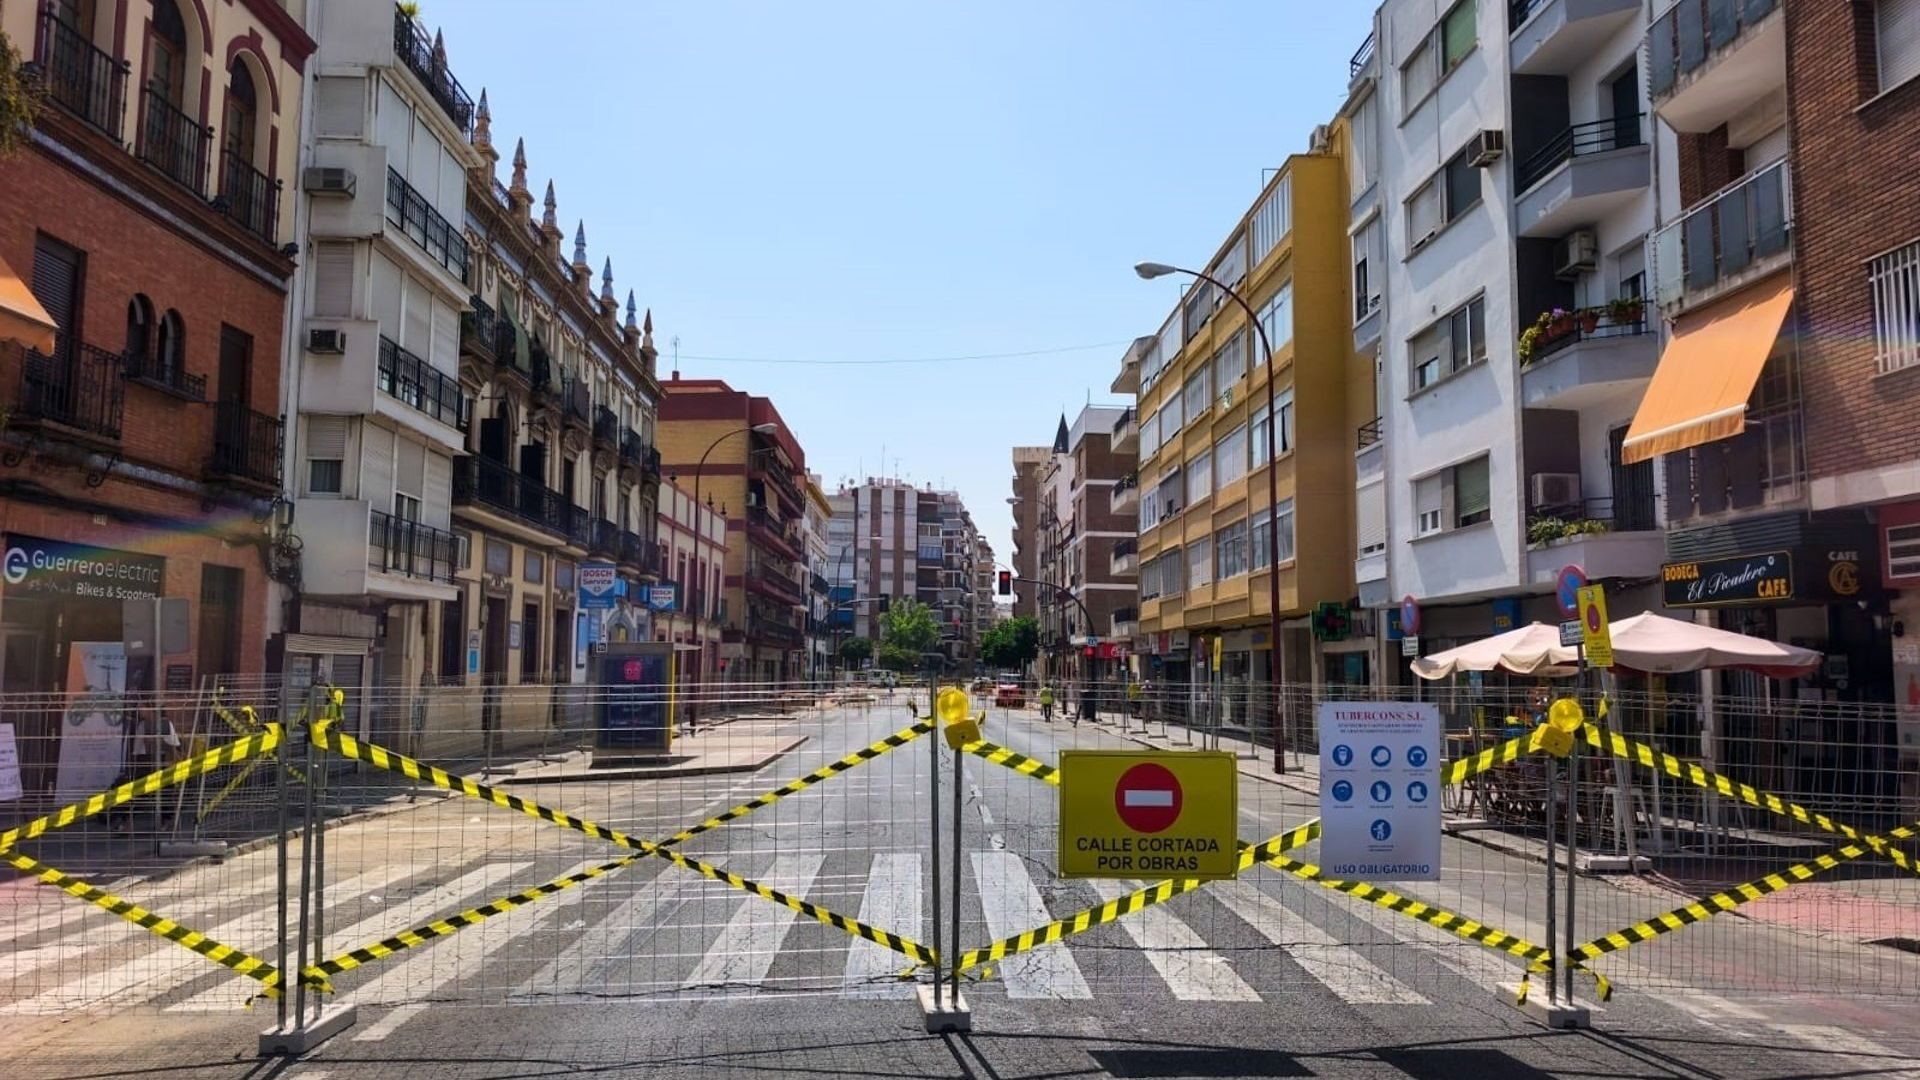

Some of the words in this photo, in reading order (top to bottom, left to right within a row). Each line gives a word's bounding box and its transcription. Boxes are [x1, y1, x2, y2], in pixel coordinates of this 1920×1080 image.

[1828, 551, 1858, 561] CAFE
[32, 550, 160, 583] Guerreroelectric
[583, 569, 612, 577] BOSCH
[1664, 564, 1699, 582] BODEGA
[1687, 580, 1704, 601] El
[1708, 562, 1767, 594] Picadero
[1757, 579, 1787, 597] CAFE
[76, 582, 104, 597] Bikes
[106, 586, 113, 597] &
[1077, 837, 1132, 852] CALLE
[1138, 838, 1219, 852] CORTADA
[1098, 856, 1133, 870] POR
[1139, 856, 1198, 870] OBRAS
[1334, 864, 1356, 874] USO
[1358, 864, 1430, 874] OBLIGATORIO
